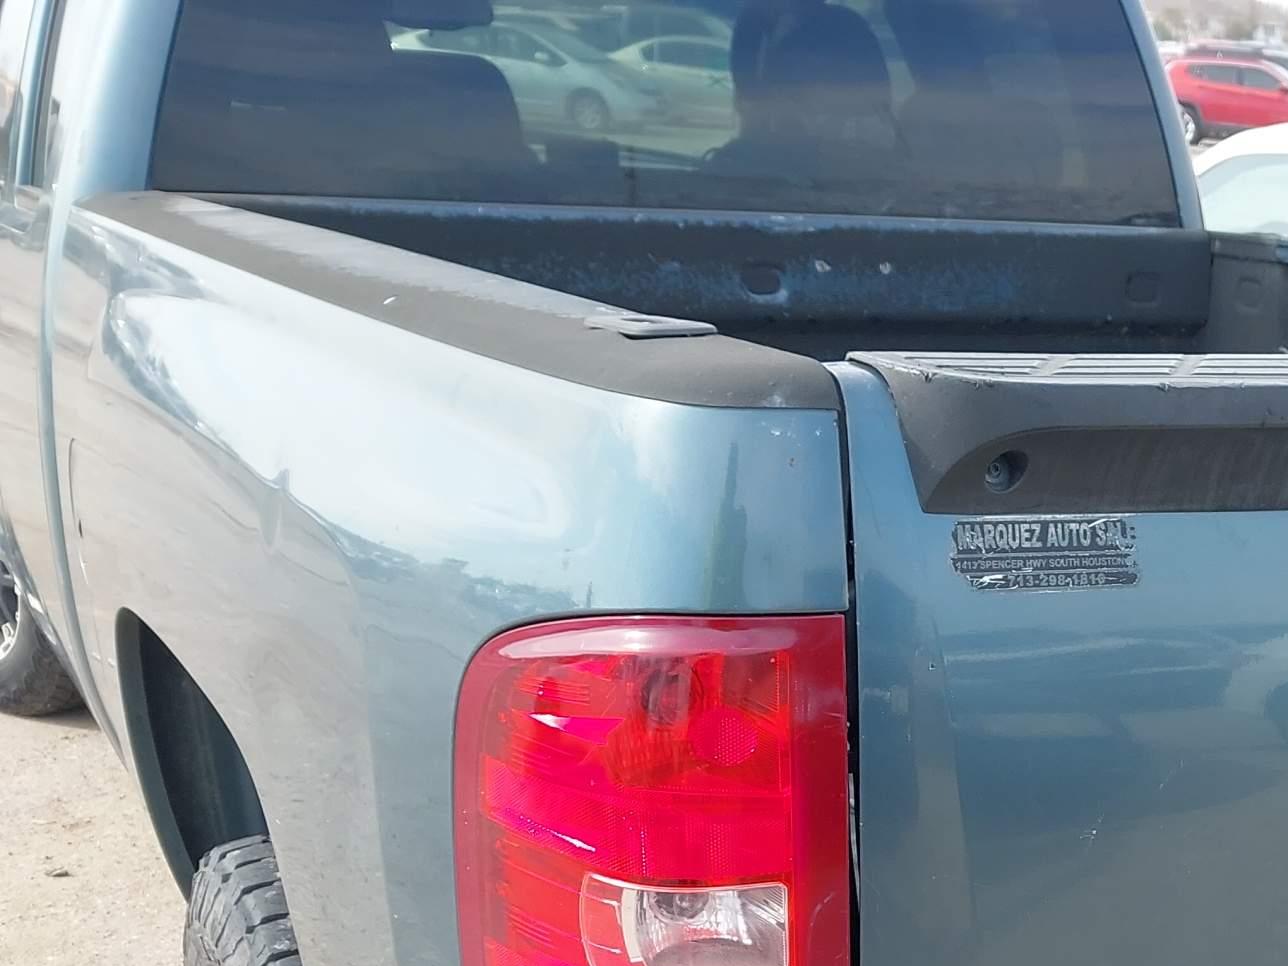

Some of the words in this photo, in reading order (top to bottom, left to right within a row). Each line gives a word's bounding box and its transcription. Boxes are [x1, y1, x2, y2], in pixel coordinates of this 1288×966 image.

[957, 523, 1042, 550] MARQUEZ
[1046, 522, 1091, 547] AUTO
[979, 559, 1024, 570] SPENCER
[1025, 558, 1047, 569] HWY
[1048, 557, 1081, 568] SOUTH
